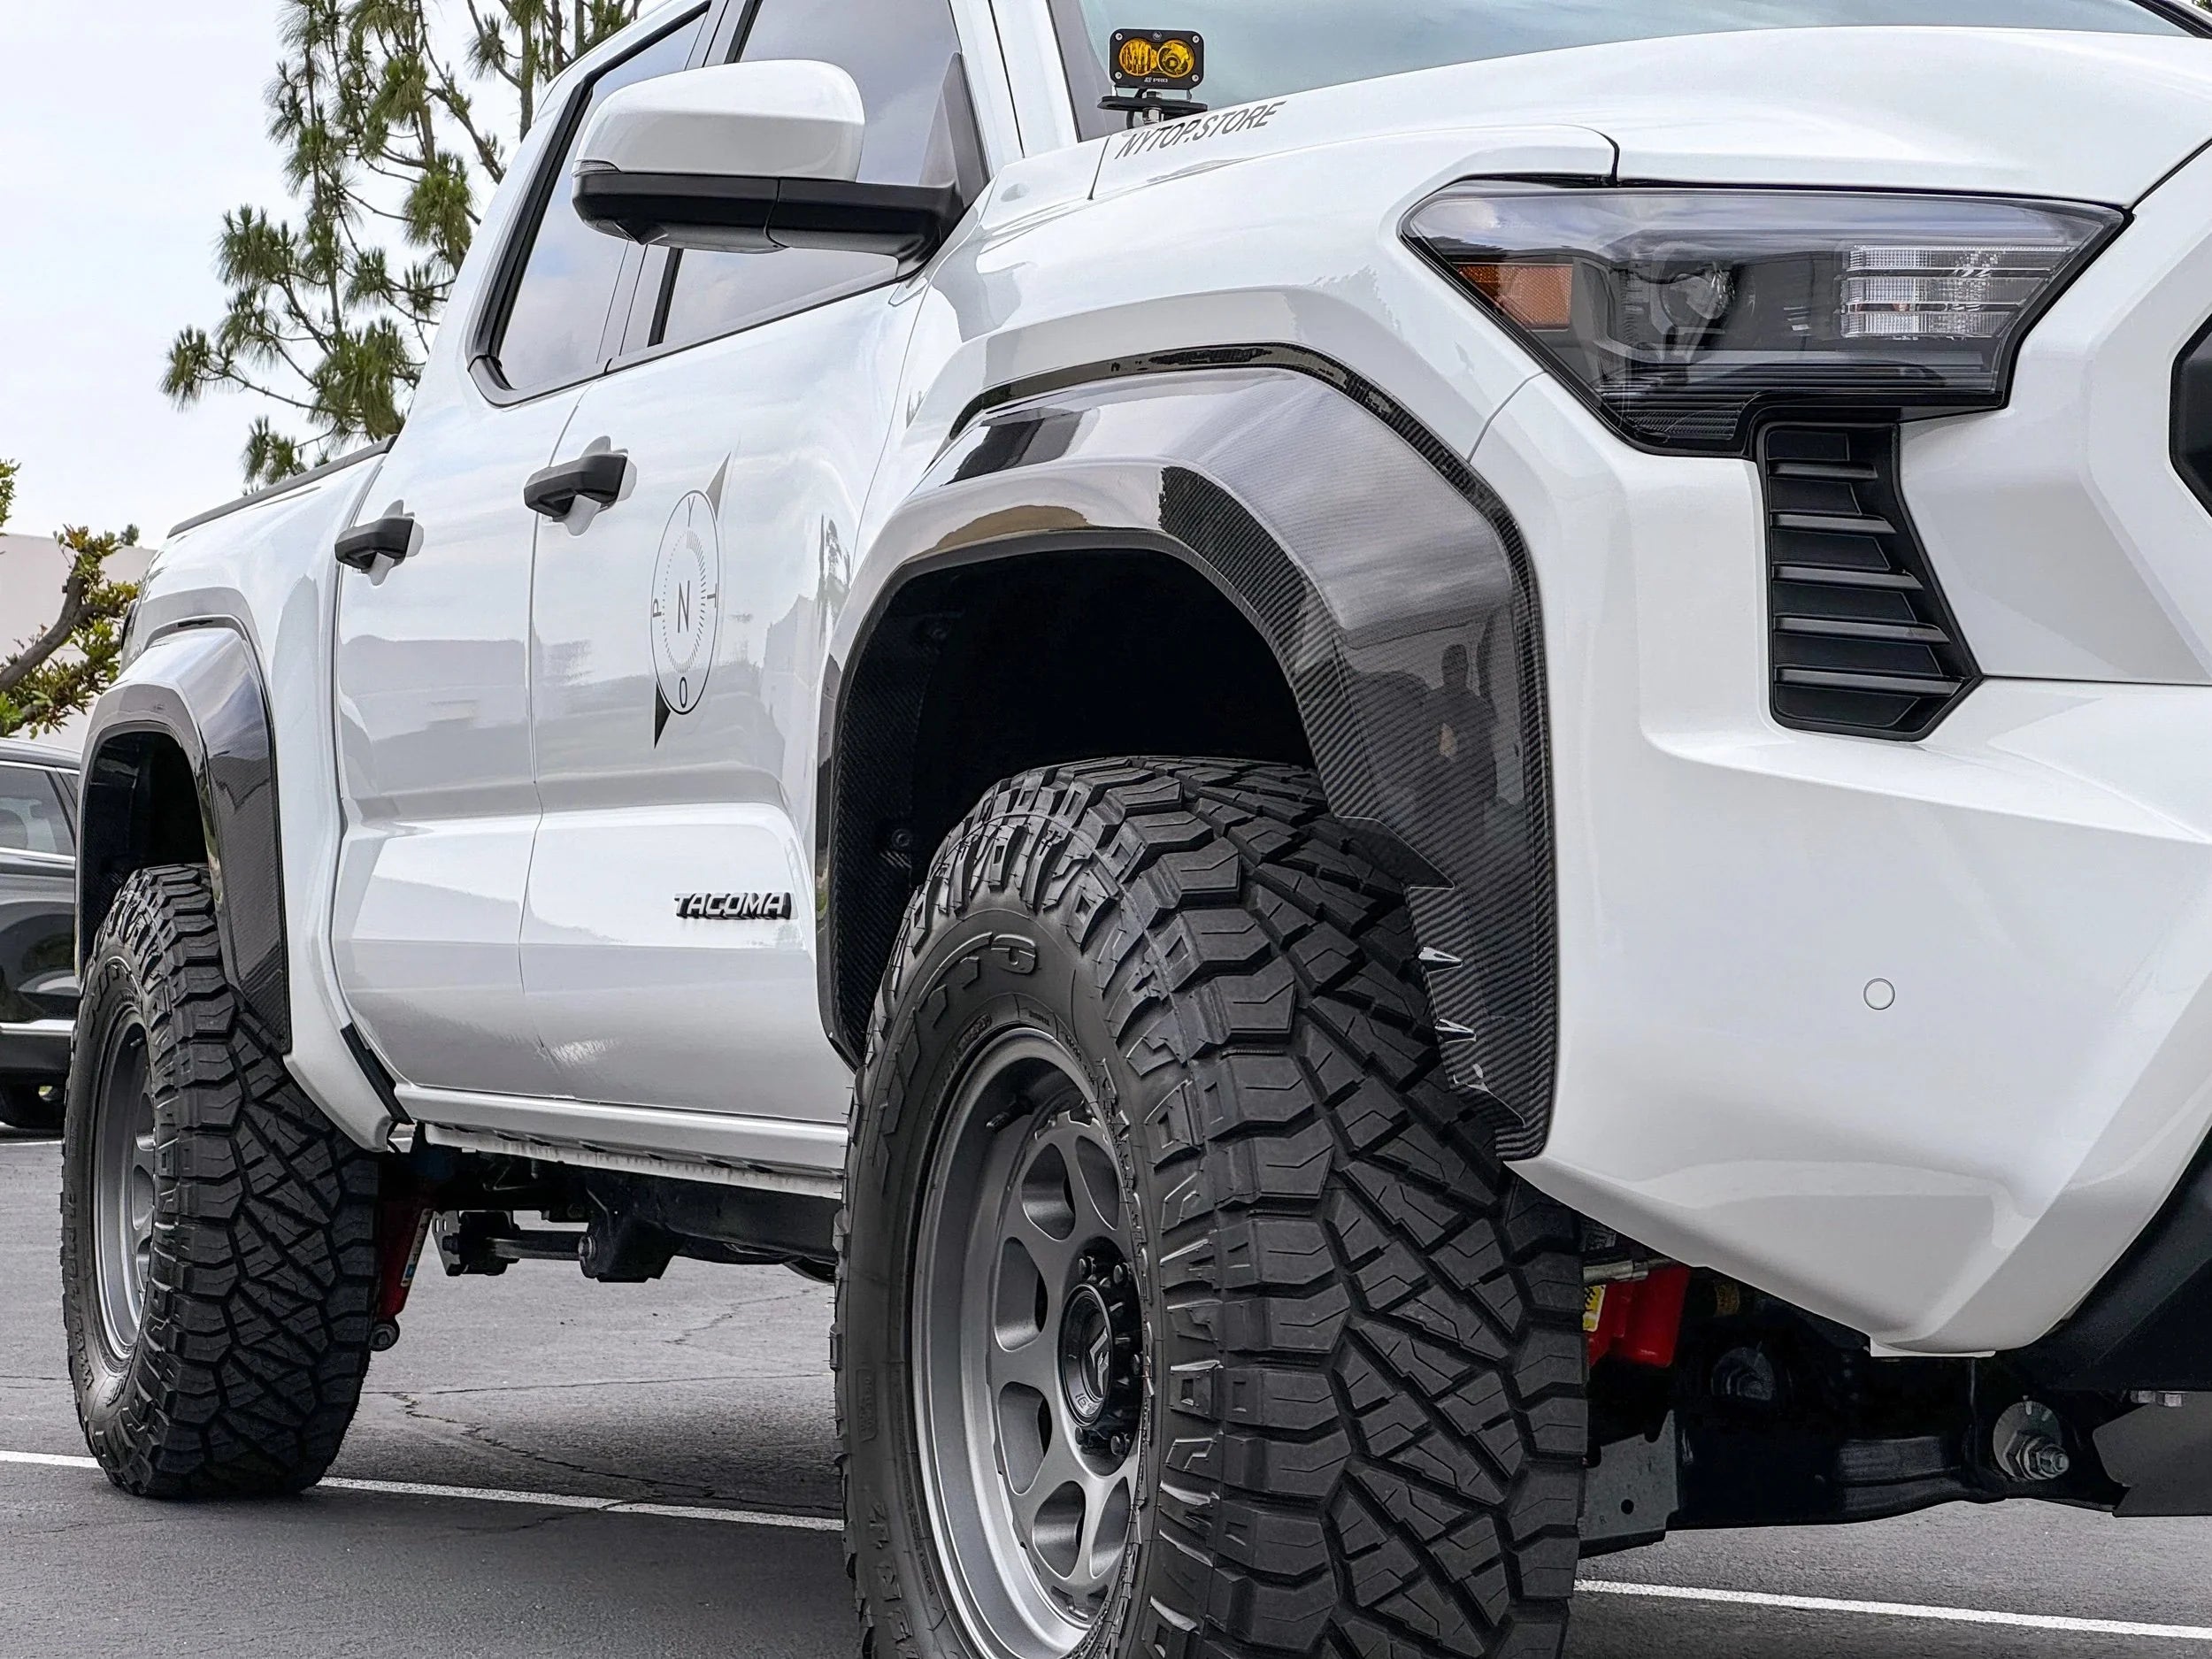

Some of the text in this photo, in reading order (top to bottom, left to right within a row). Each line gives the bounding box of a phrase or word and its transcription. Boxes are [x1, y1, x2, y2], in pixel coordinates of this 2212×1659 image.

[1114, 100, 1286, 160] NYTOP.STORE
[687, 495, 695, 527] Y
[652, 597, 663, 618] P
[677, 580, 691, 634] N
[674, 892, 791, 920] TACOMA
